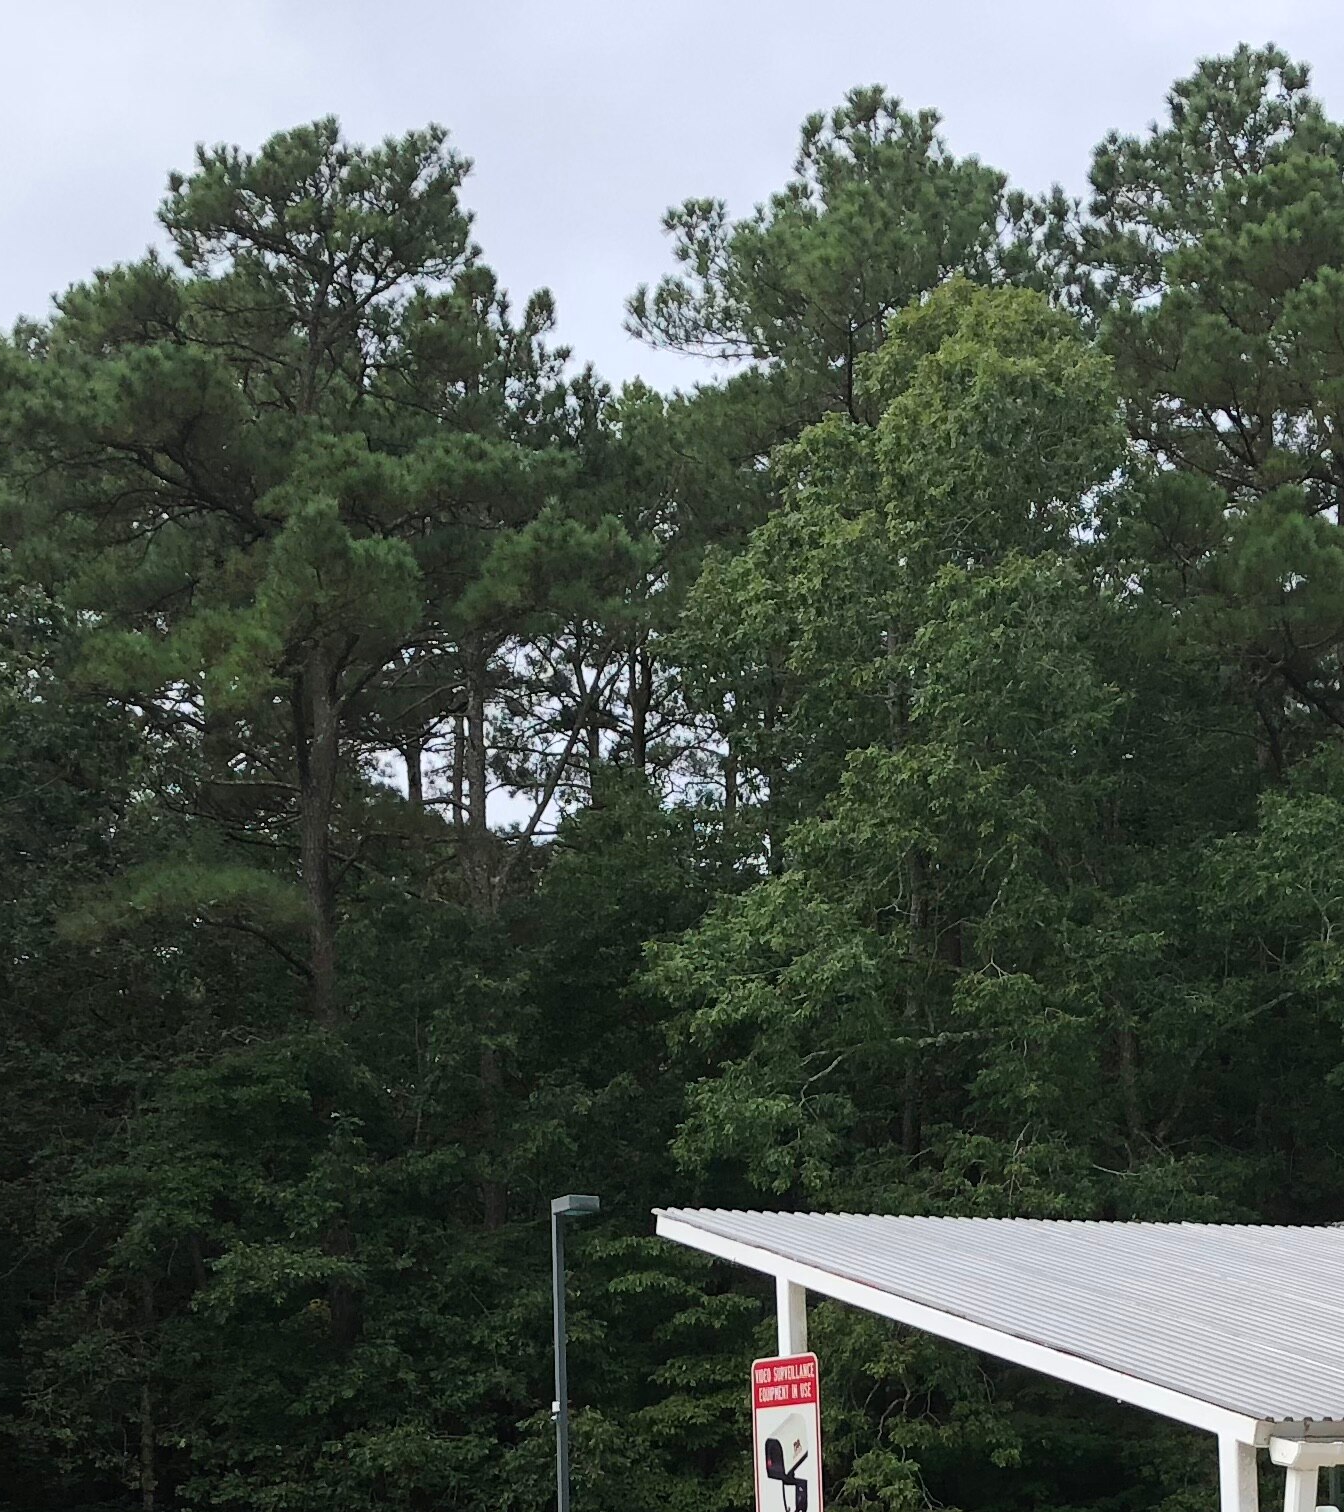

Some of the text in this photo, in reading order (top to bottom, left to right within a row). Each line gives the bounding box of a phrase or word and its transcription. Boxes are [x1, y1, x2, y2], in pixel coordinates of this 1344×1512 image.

[754, 1362, 815, 1384] VIDEO SURVEILLANCE
[758, 1382, 812, 1403] EQUIPMENT IN USE
